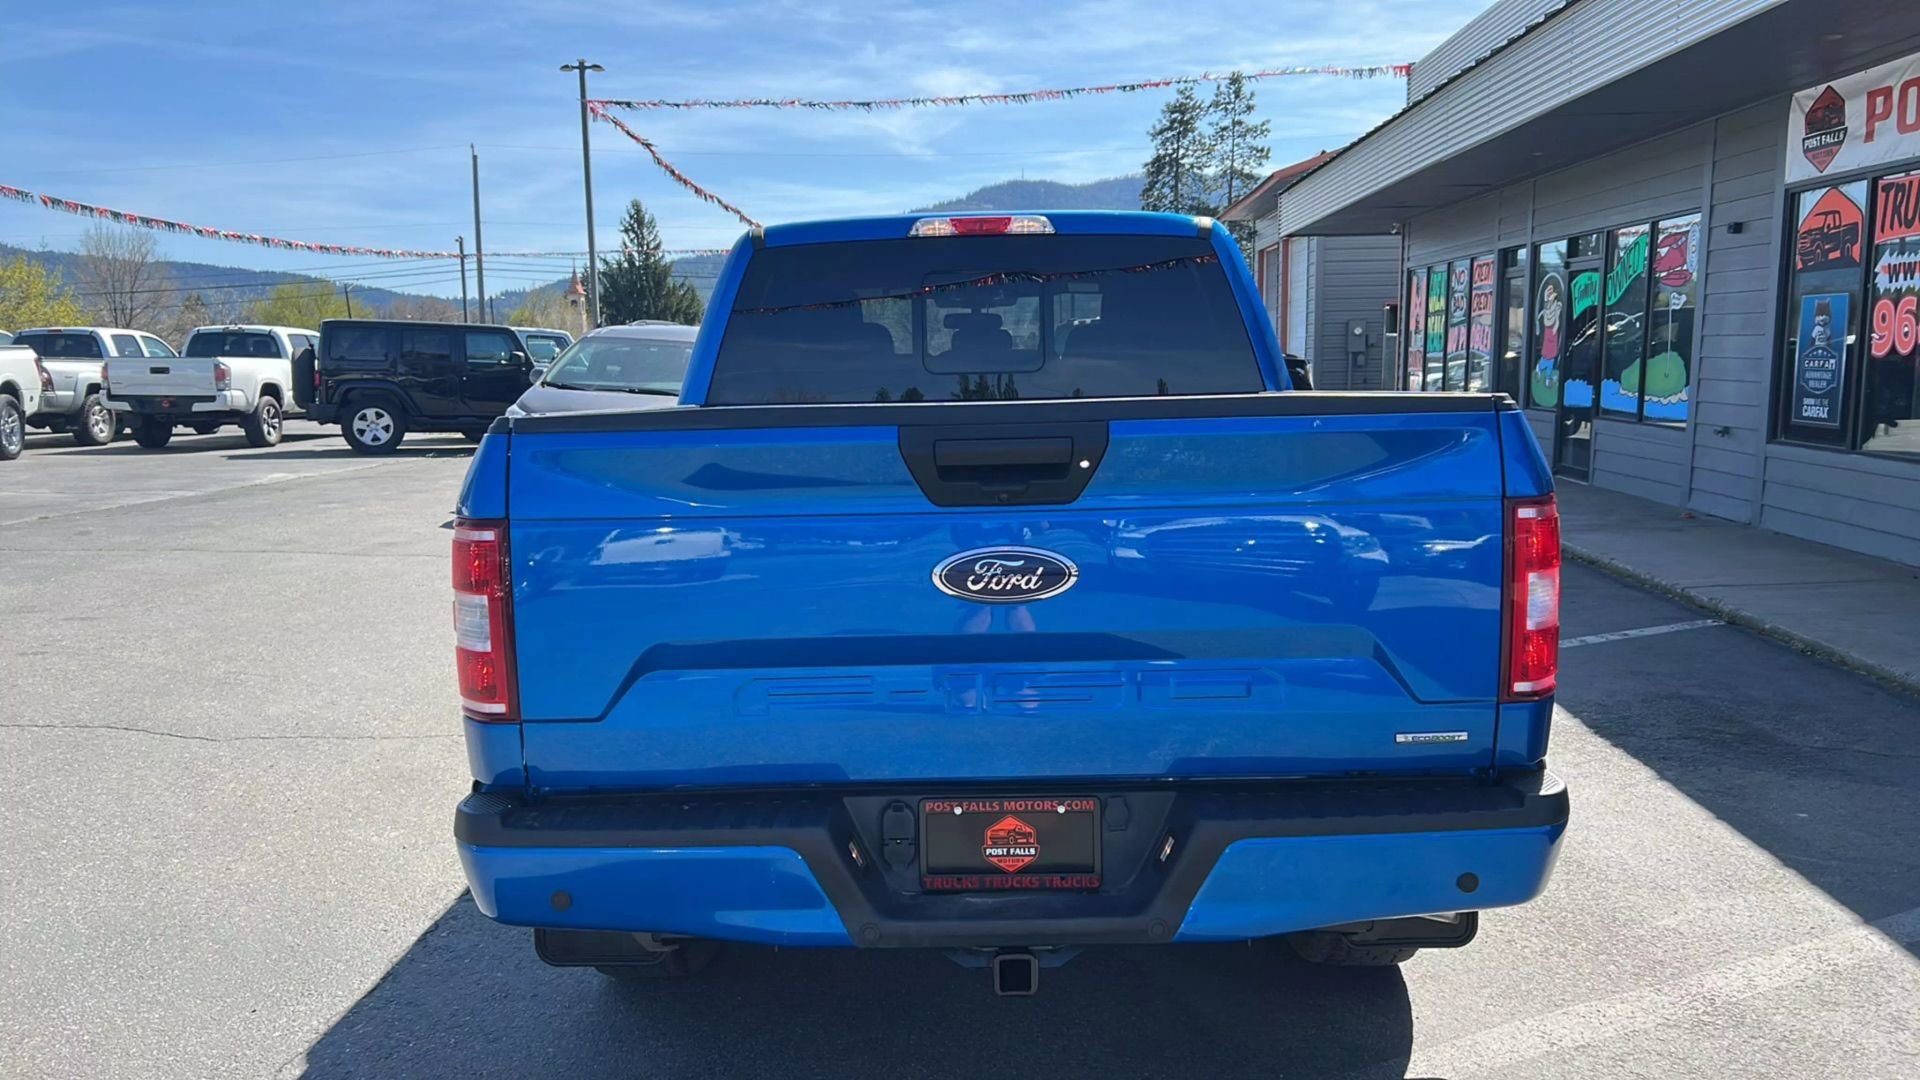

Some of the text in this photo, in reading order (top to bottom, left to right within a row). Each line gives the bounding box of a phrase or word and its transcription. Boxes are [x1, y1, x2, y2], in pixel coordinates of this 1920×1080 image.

[1804, 130, 1845, 150] POST FALLS
[1881, 178, 1920, 234] TRU
[1802, 405, 1829, 418] CARFAX
[966, 559, 1044, 591] Ford
[926, 801, 958, 812] POST
[962, 801, 1000, 812] FALLS
[986, 847, 1036, 856] POST FALLS
[923, 875, 1100, 889] TRUCKS TRUCKS TRUCKS
